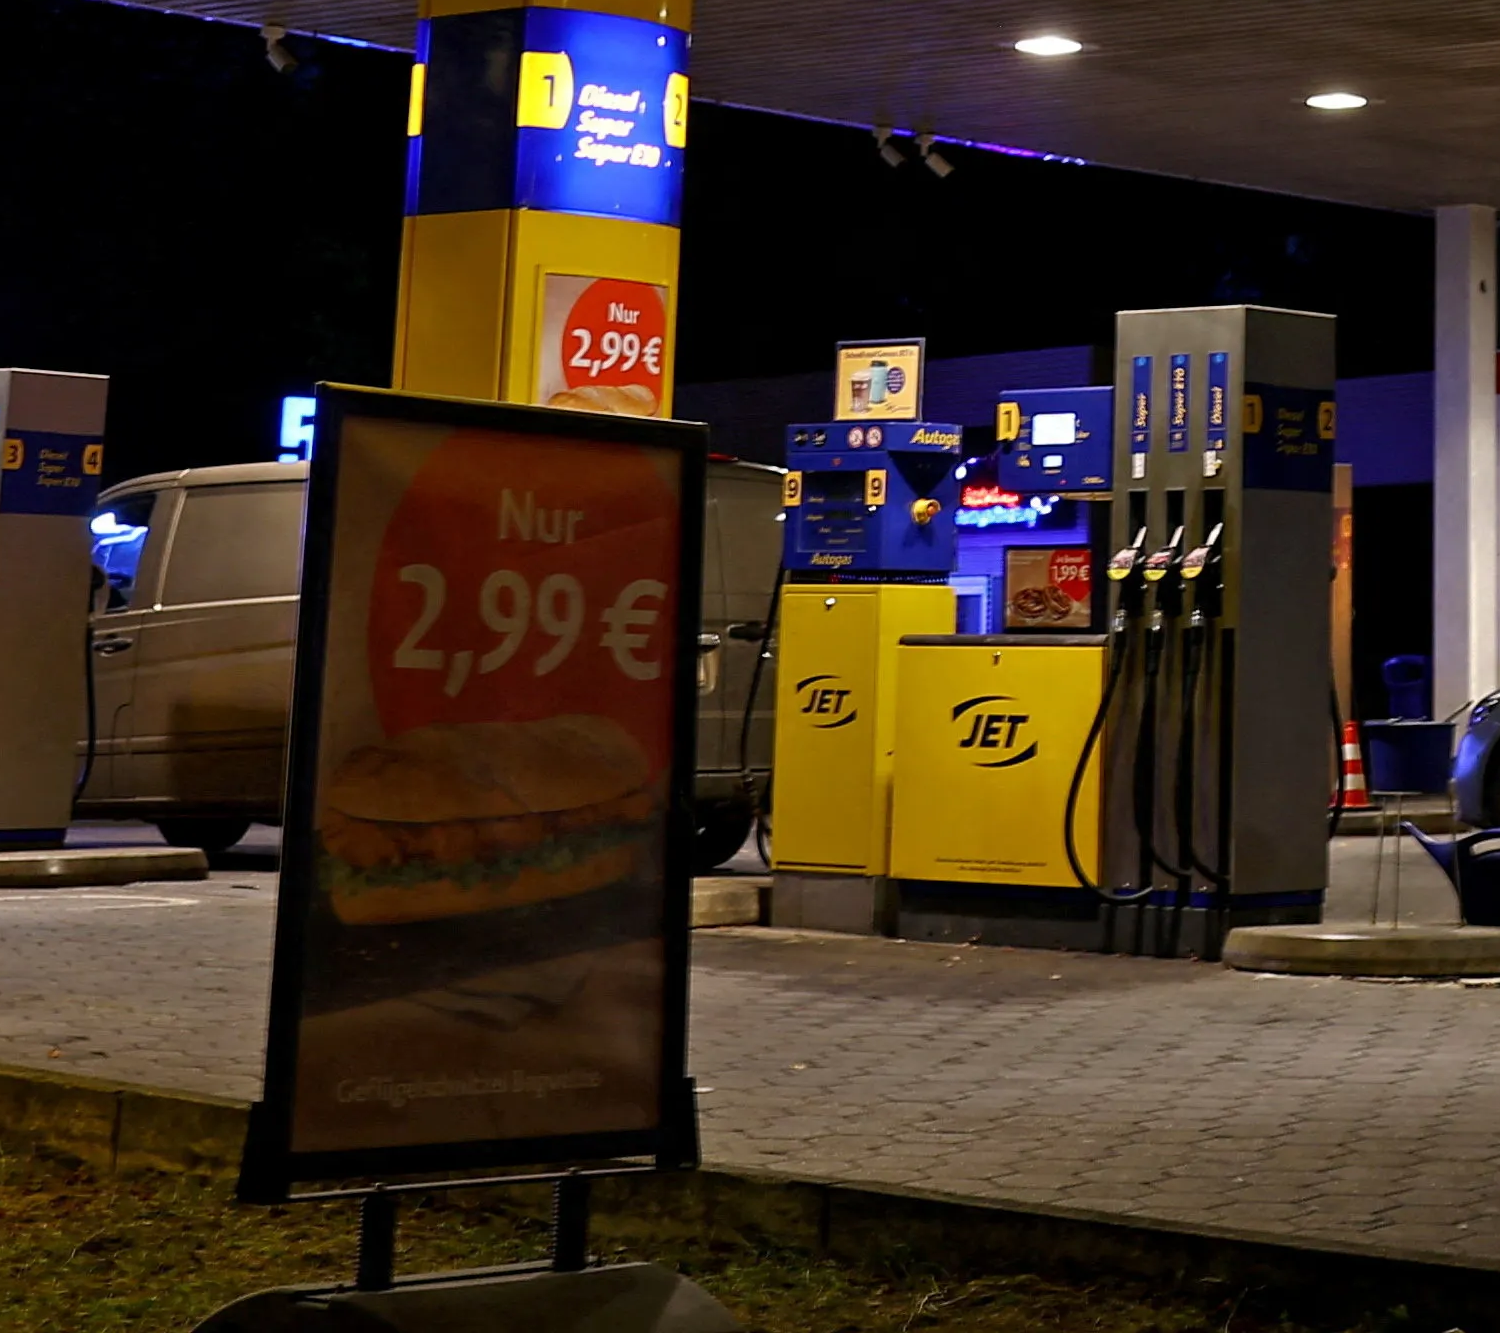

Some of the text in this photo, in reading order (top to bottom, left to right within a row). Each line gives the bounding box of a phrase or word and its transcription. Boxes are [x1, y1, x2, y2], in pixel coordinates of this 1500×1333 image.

[543, 75, 555, 108] 1
[607, 301, 640, 324] Nur
[1003, 410, 1012, 432] 1
[1248, 402, 1256, 426] 1
[1323, 409, 1333, 431] 2
[10, 445, 18, 464] 3
[87, 450, 98, 469] 4
[788, 478, 798, 498] 9
[871, 477, 882, 497] 9
[498, 487, 584, 545] Nur
[801, 689, 852, 714] JET
[959, 714, 1030, 749] JET
